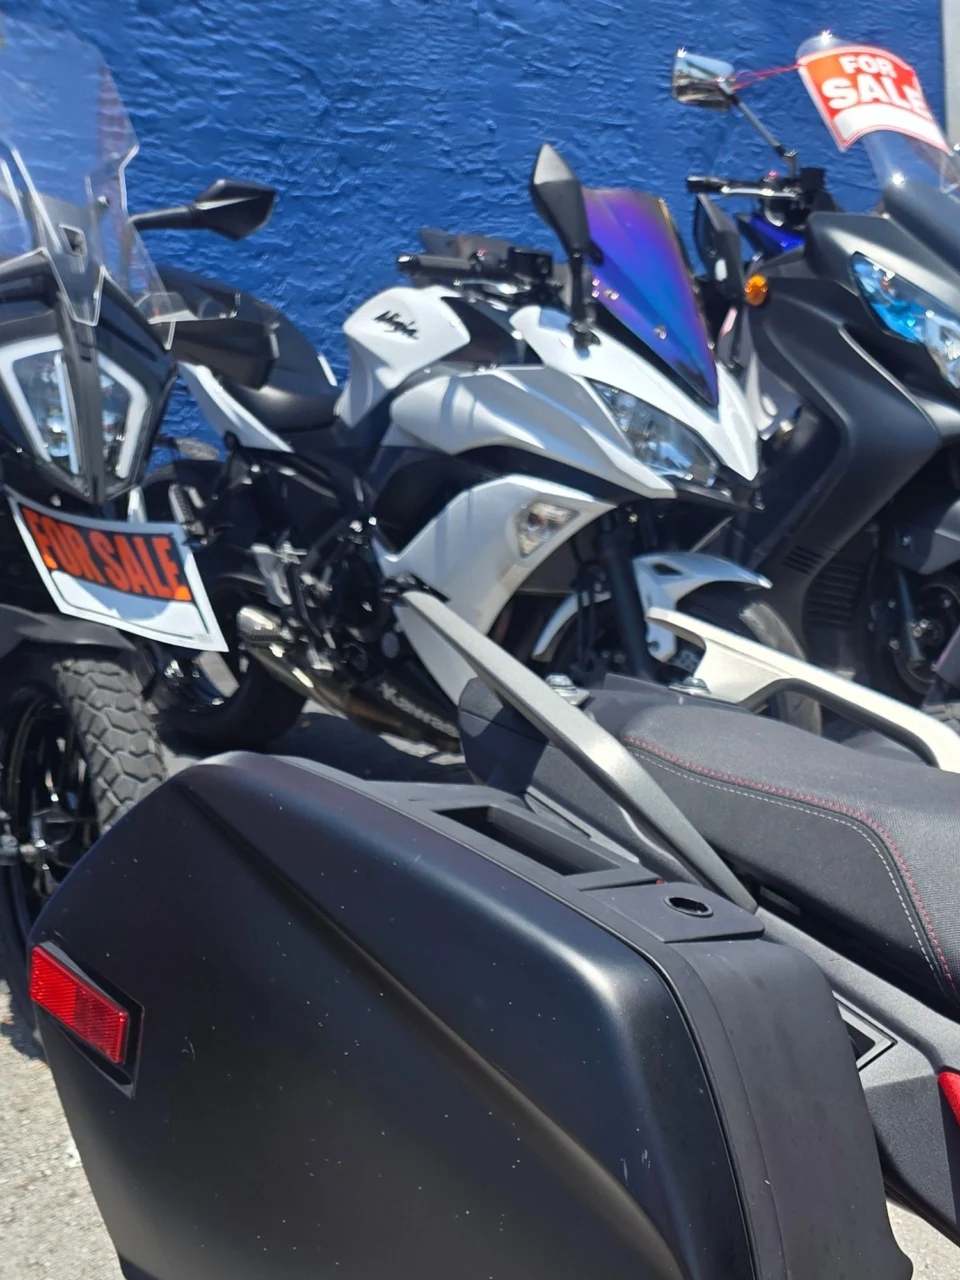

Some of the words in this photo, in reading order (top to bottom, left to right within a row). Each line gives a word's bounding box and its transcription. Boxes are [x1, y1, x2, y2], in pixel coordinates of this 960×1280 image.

[838, 55, 897, 79] FOR
[821, 74, 933, 121] SALE
[373, 310, 420, 340] Ninja
[22, 506, 106, 586] FOR
[88, 530, 193, 602] SALE
